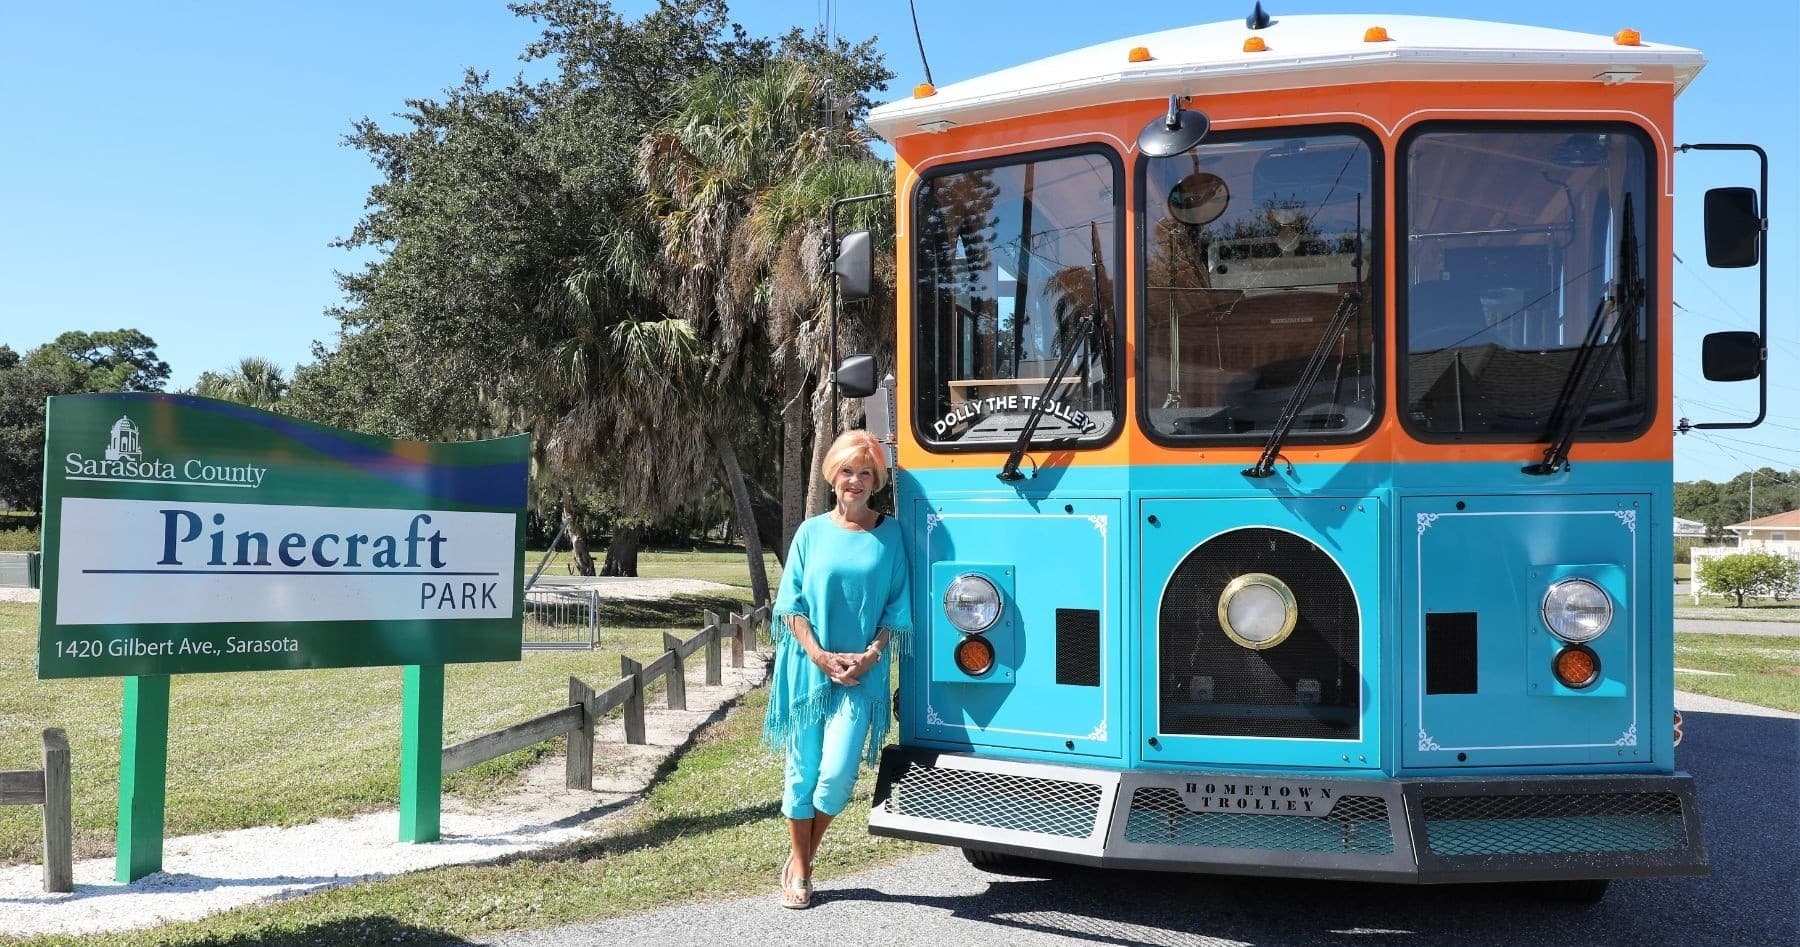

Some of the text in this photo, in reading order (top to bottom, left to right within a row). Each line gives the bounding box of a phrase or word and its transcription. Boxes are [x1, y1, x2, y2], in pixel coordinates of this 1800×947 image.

[934, 400, 983, 435] DOLLY
[986, 395, 1018, 411] THE
[65, 453, 266, 488] Sarasota County
[156, 509, 448, 568] Pinecraft
[421, 582, 498, 610] PARK
[55, 636, 299, 658] 1420 Gilbert Ave., Sarasota
[1185, 782, 1333, 799] HOMETOWN
[1201, 796, 1315, 812] TROLLEY
